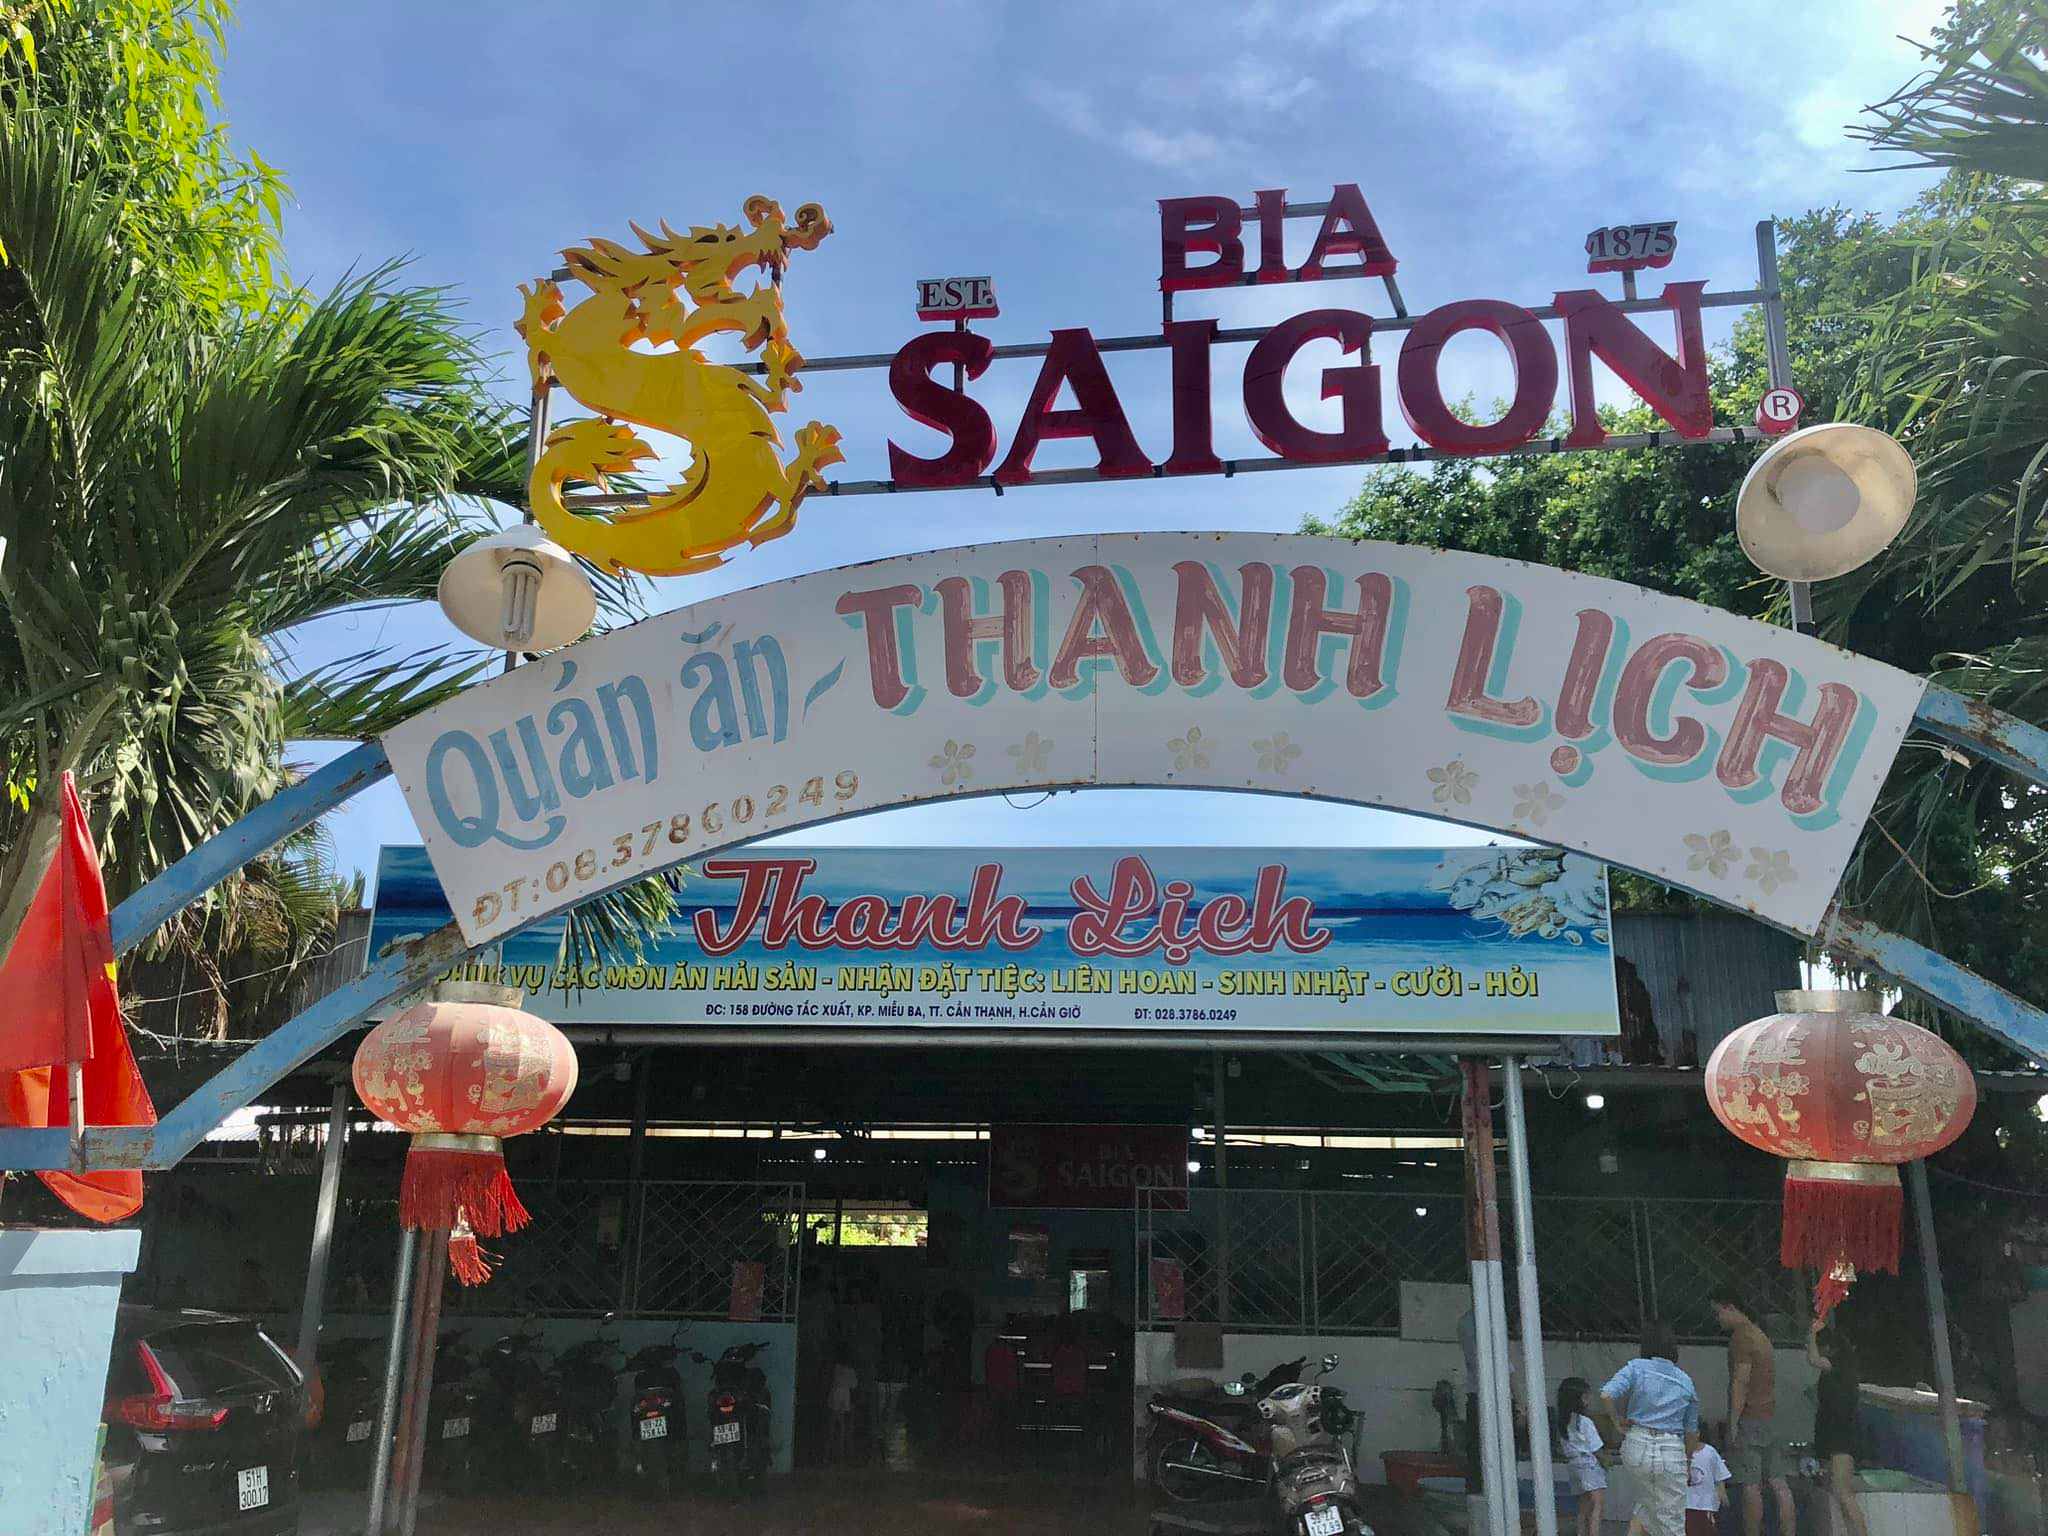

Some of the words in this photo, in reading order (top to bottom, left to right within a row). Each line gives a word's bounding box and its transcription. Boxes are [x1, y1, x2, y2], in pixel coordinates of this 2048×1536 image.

[1156, 183, 1400, 291] BIA
[1587, 223, 1676, 263] 1875
[917, 278, 996, 310] EST.
[887, 280, 1714, 488] SAIGON
[425, 661, 657, 850] Quán
[837, 560, 1402, 713] THANH
[1444, 585, 1868, 822] LỊCH
[694, 857, 1044, 956] Thanh
[1066, 853, 1333, 965] Lịch
[510, 964, 545, 996] VỤ
[669, 959, 707, 990] ĂN
[712, 958, 759, 991] HẢI
[762, 959, 817, 992] SẢN
[838, 961, 912, 999] NHẬN
[919, 962, 972, 1000] ĐẶT
[977, 961, 1045, 999] TIỆC:
[1051, 963, 1112, 993] LIÊN
[1118, 969, 1196, 995] HOAN
[1217, 970, 1286, 996] SINH
[1292, 966, 1369, 1003] NHẬT
[1485, 964, 1539, 997] HỎI
[705, 1003, 726, 1016] ĐC:
[730, 1004, 748, 1016] 158
[907, 1005, 926, 1019] BA,
[1134, 1008, 1152, 1020] ĐT:
[1155, 1008, 1237, 1022] 028.3786.0249
[240, 1486, 268, 1509] 300.17
[245, 1469, 262, 1488] 51H
